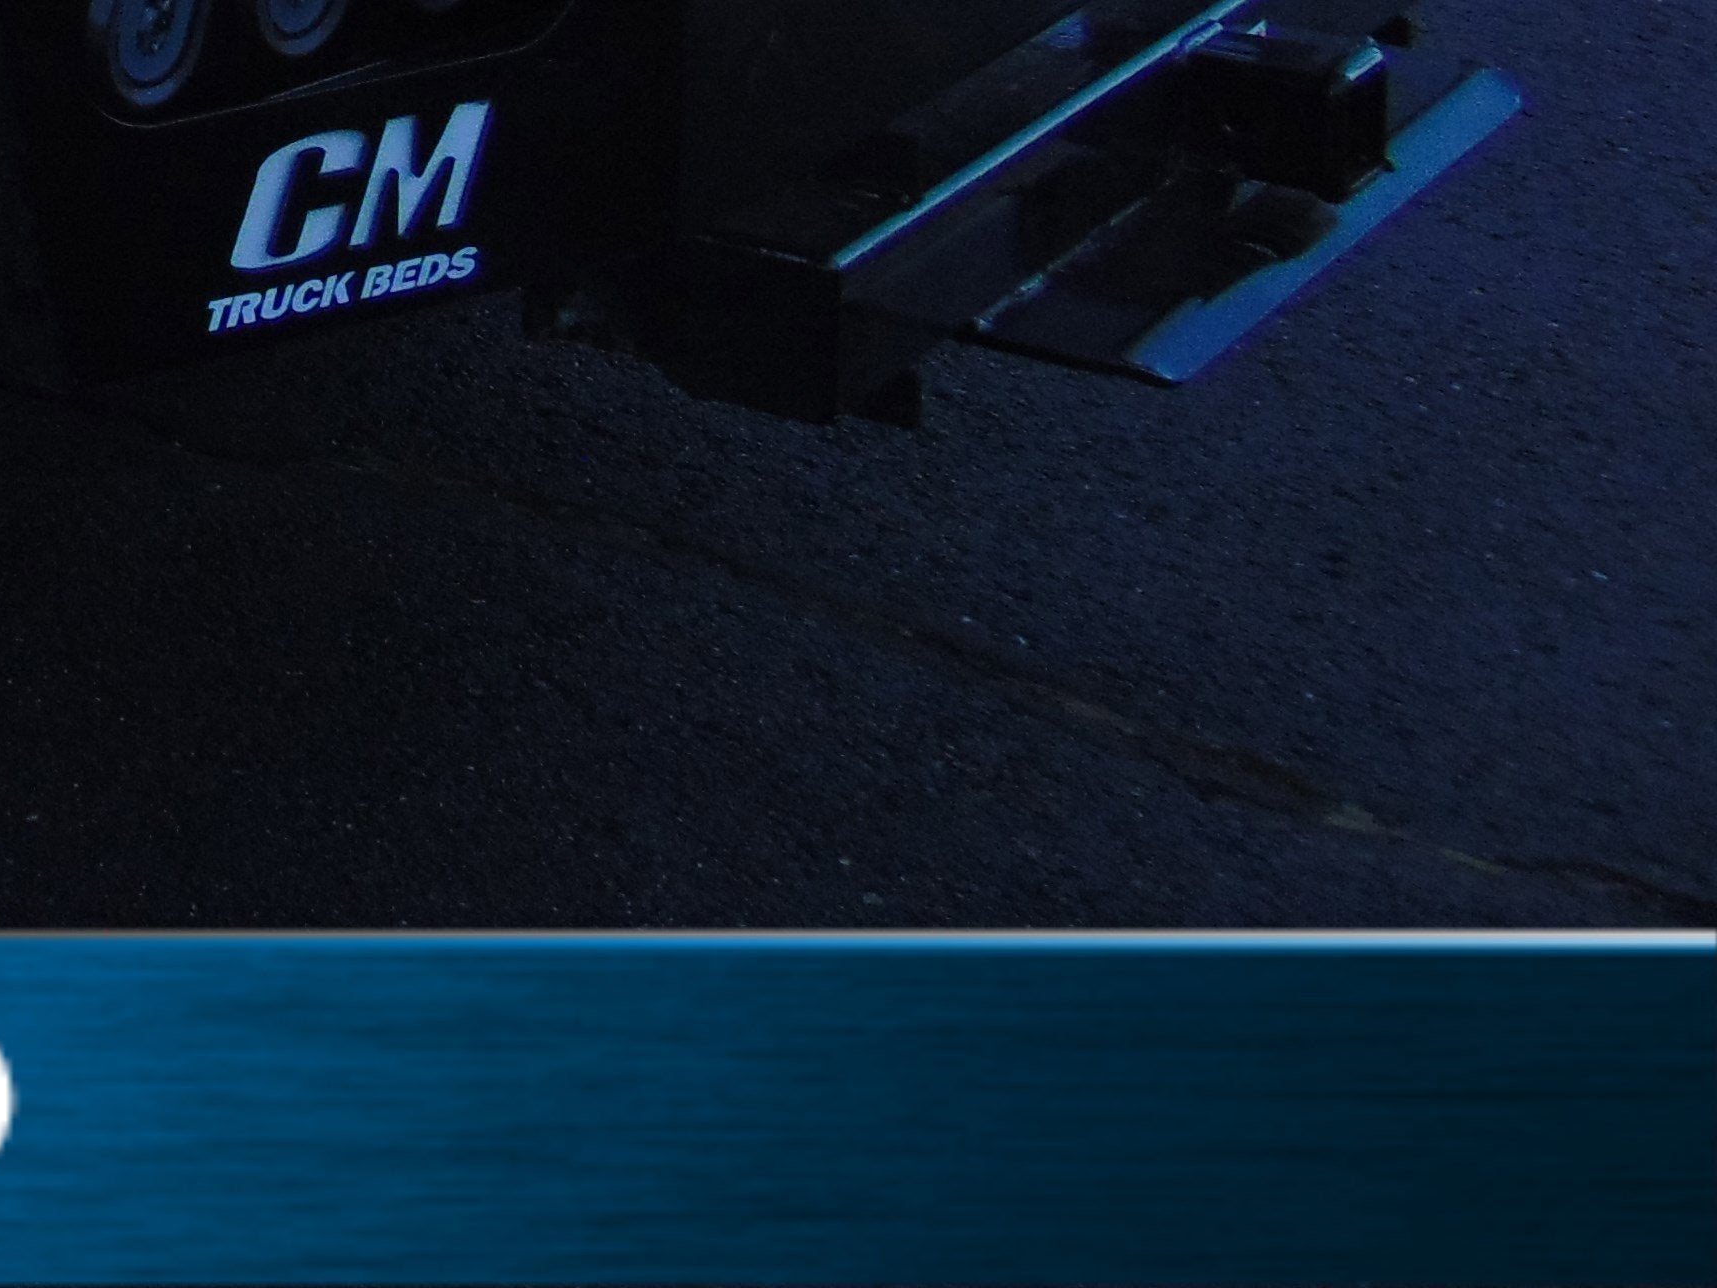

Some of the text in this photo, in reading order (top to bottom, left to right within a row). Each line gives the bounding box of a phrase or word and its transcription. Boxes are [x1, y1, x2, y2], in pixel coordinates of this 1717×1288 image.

[230, 99, 492, 270] CM
[206, 244, 479, 334] TRUCK BEDS
